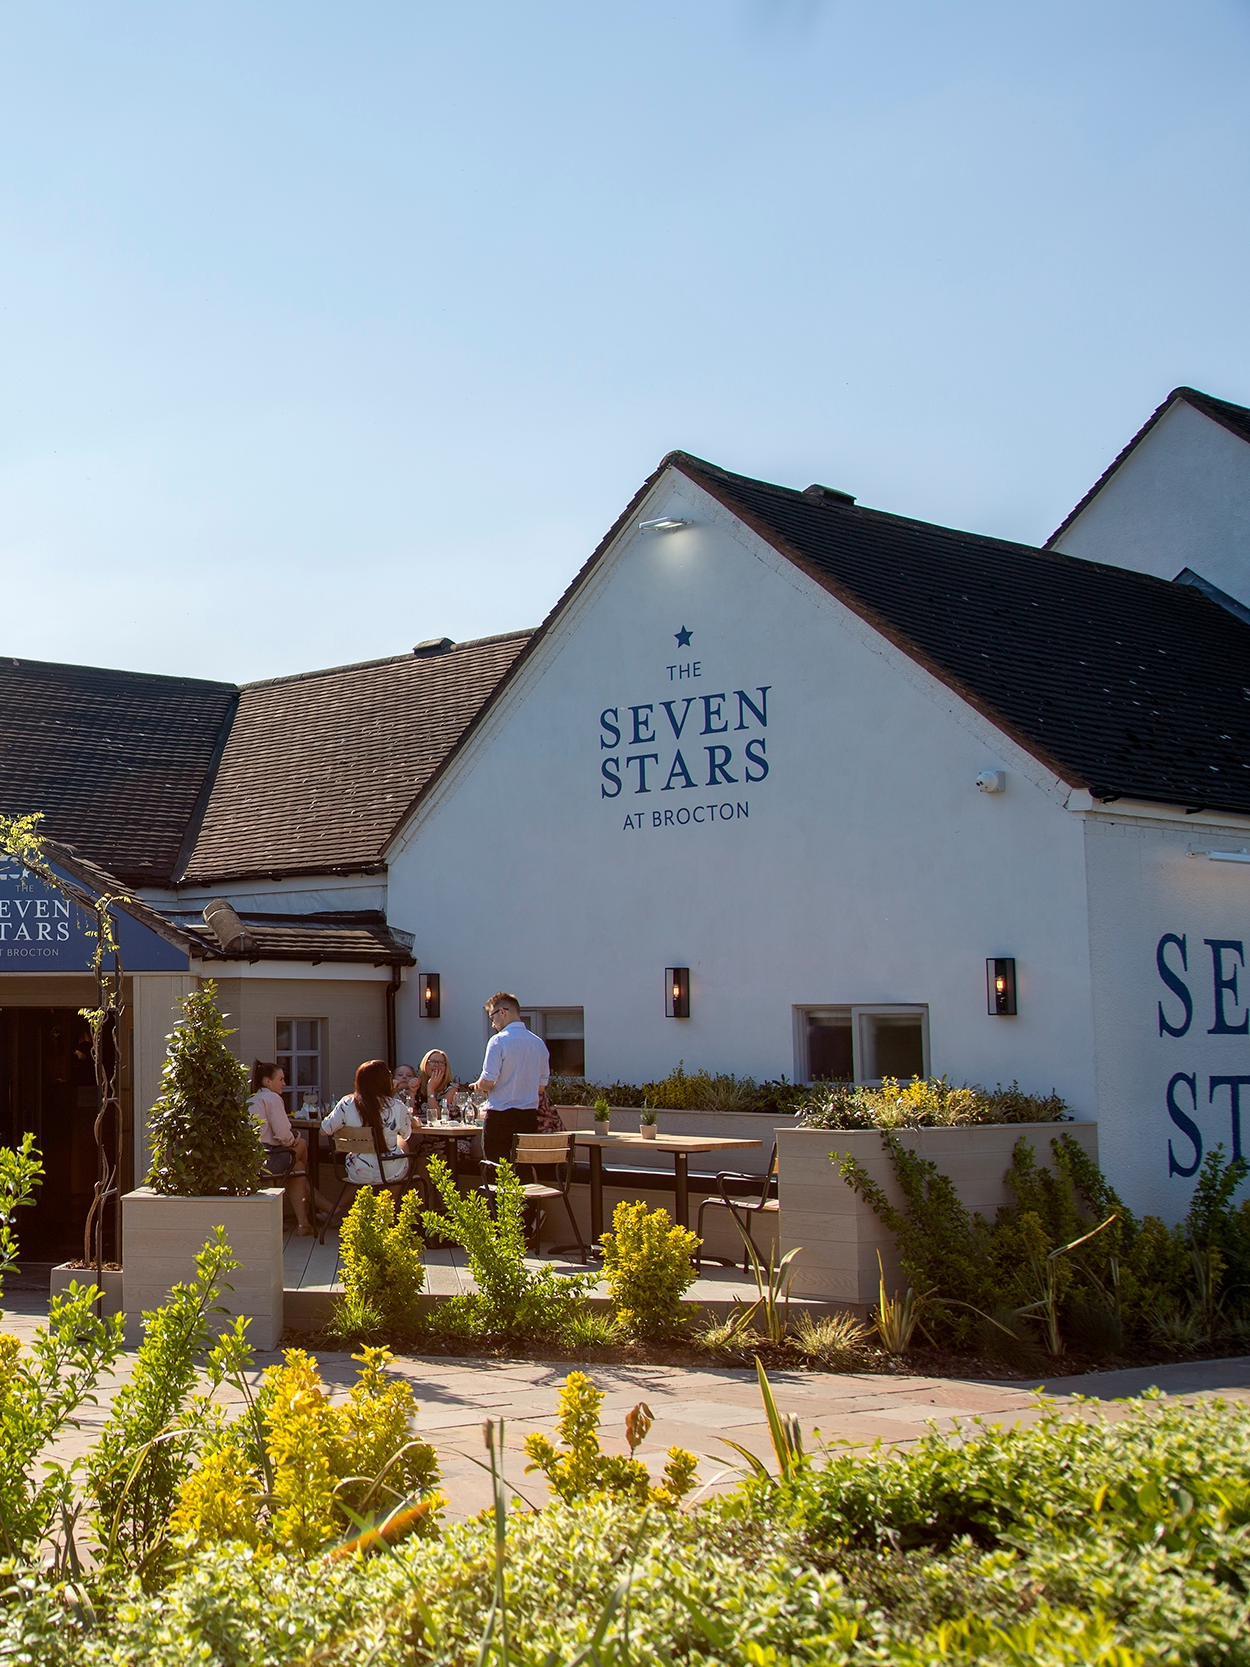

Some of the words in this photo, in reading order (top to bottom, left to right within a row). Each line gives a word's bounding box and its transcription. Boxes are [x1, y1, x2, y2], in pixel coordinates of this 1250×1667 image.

[666, 661, 702, 681] THE
[600, 685, 772, 750] SEVEN
[600, 737, 770, 799] STARS
[622, 812, 645, 831] AT
[652, 801, 749, 828] BROCTON
[15, 884, 34, 893] THE
[7, 948, 59, 957] BROCTON
[1156, 933, 1250, 1038] SE
